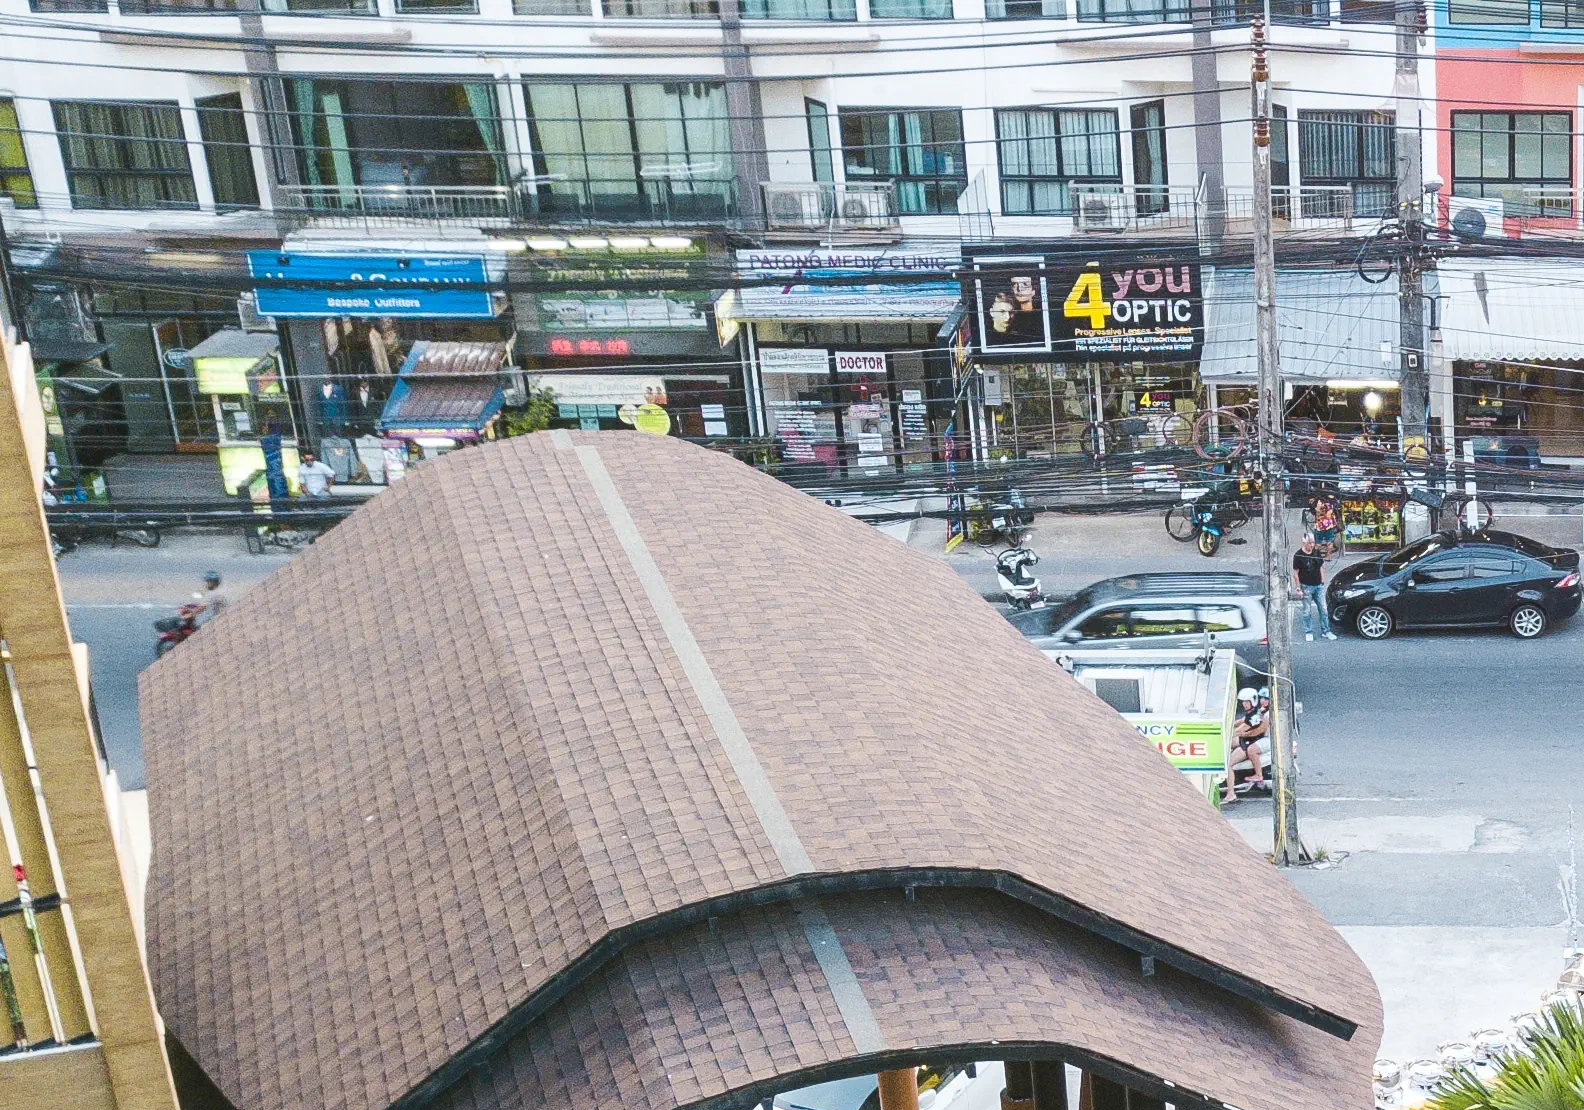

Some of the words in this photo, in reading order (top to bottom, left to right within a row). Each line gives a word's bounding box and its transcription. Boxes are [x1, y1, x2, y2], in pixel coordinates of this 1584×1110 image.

[749, 254, 821, 270] PATONG
[889, 256, 949, 270] CLINIC
[1111, 265, 1192, 300] you
[1063, 261, 1112, 330] 4
[1112, 299, 1192, 323] OPTIC
[839, 356, 884, 370] DOCTOR
[1139, 391, 1152, 408] 4
